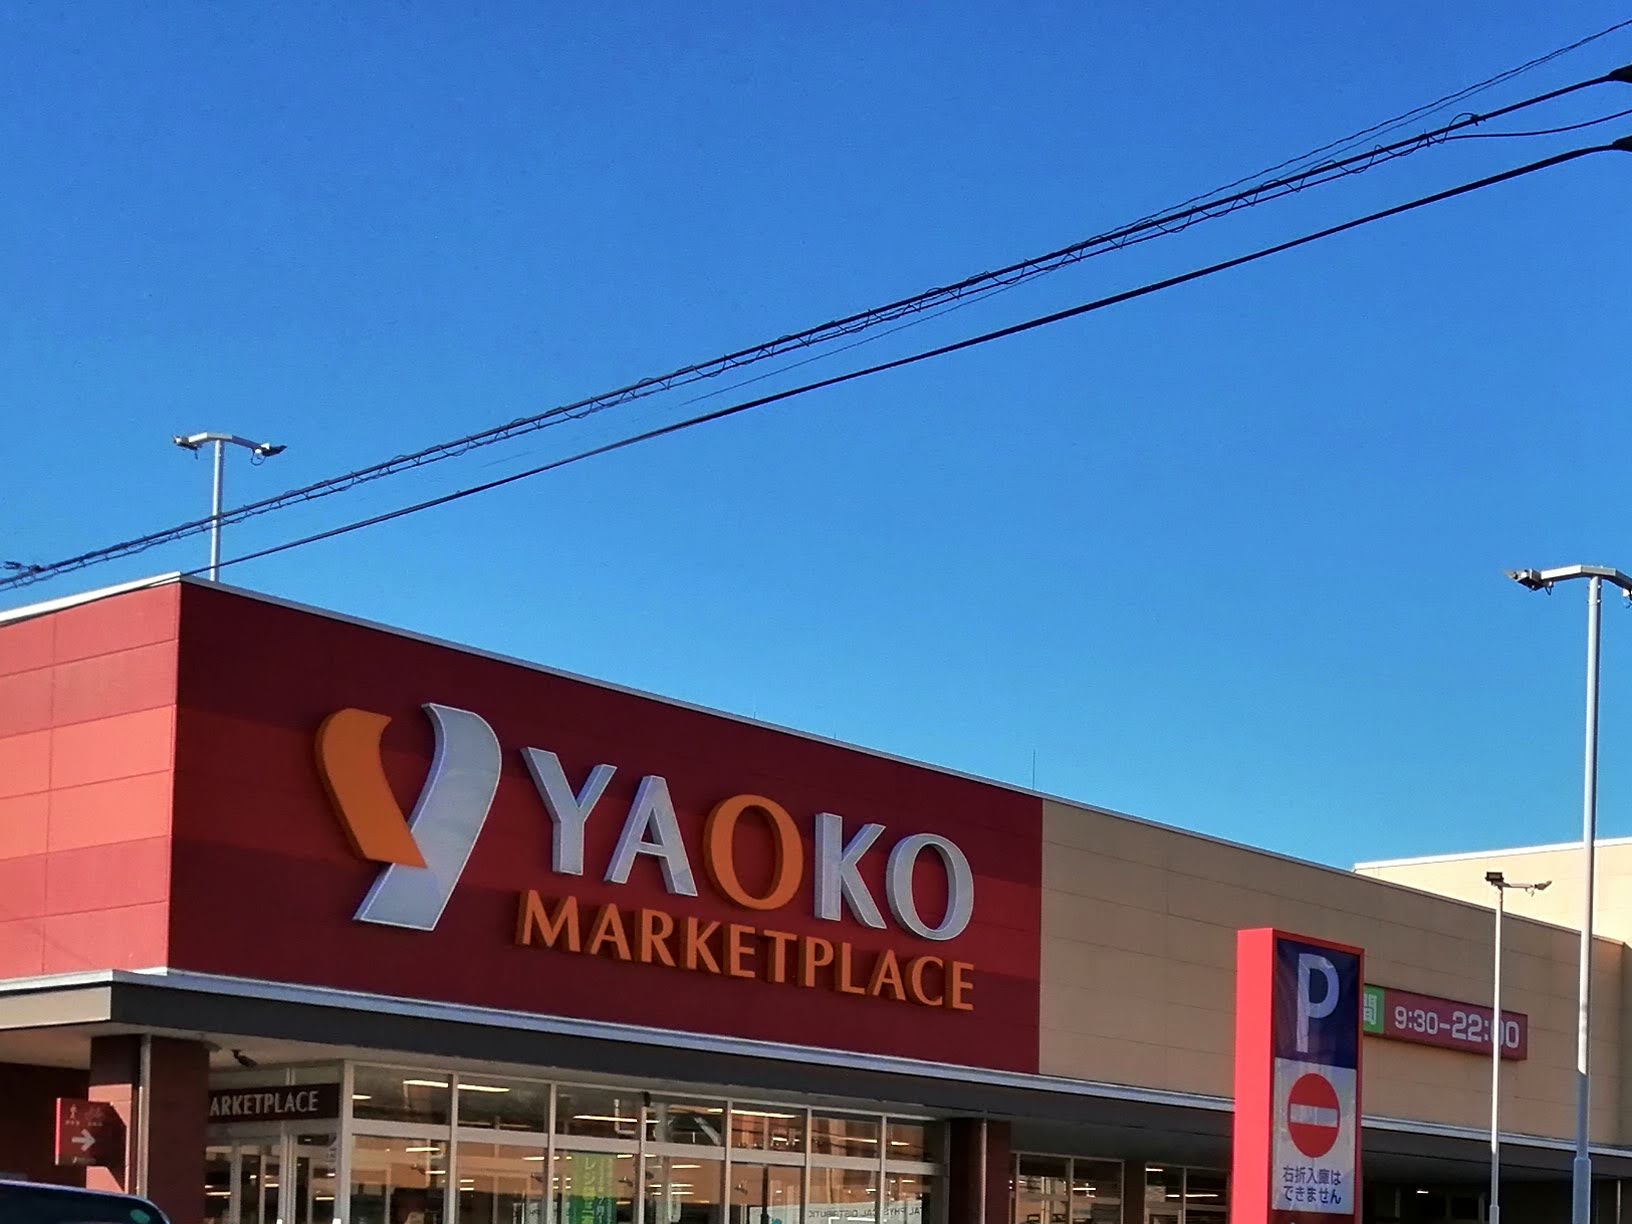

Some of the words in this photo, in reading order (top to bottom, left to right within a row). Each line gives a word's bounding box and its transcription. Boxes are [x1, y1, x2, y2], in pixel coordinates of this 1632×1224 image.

[519, 746, 975, 942] YAOKO
[516, 888, 975, 1011] MARKETPLACE
[1296, 952, 1340, 1054] P
[1282, 1164, 1342, 1186] 右折入庫は
[1282, 1185, 1342, 1205] できません
